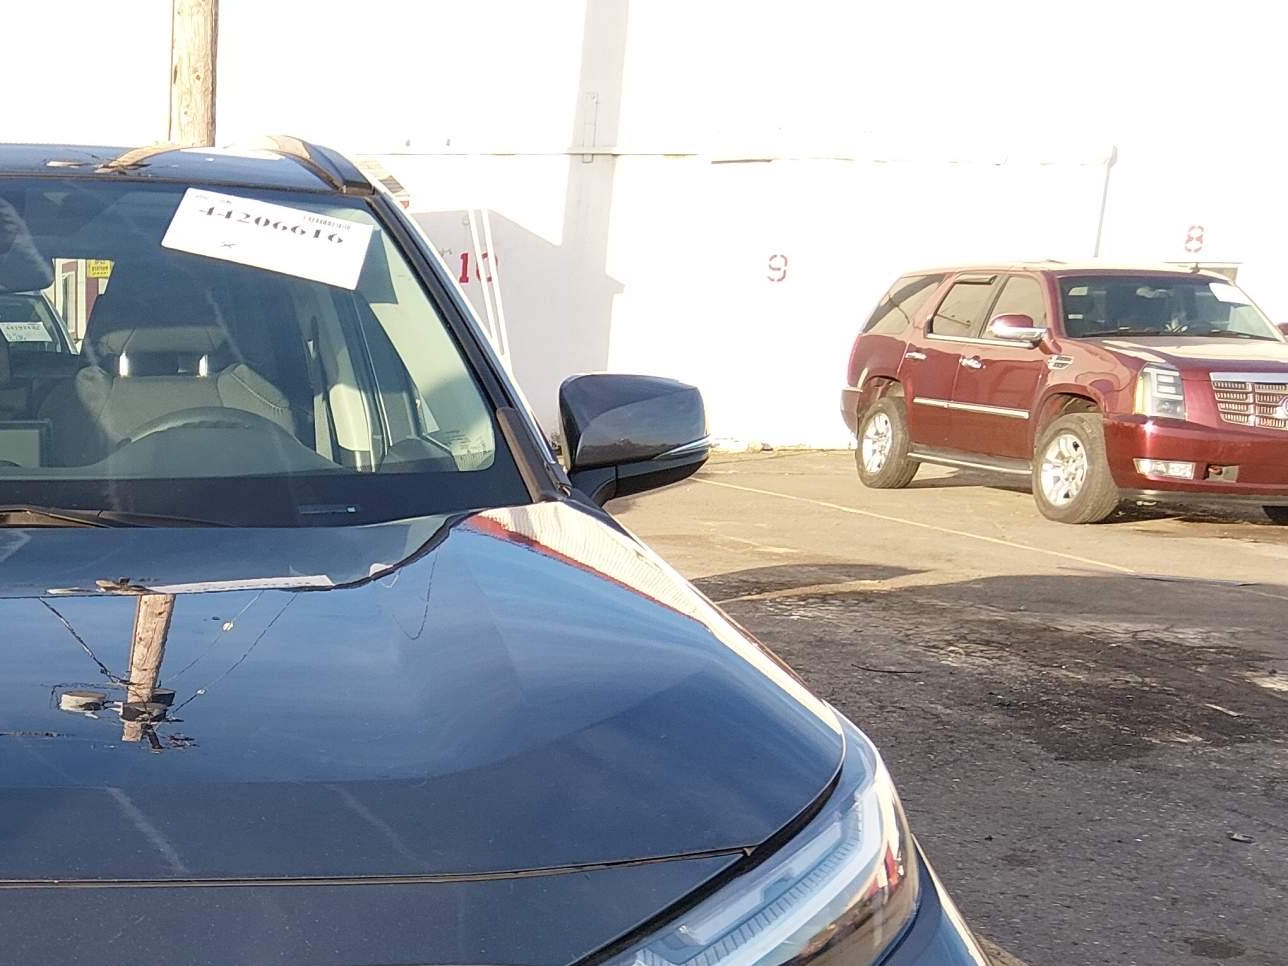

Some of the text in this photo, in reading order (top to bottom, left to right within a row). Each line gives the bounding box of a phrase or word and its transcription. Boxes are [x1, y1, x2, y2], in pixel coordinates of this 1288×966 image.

[199, 206, 344, 243] 44206616
[1184, 225, 1204, 253] 8
[767, 254, 788, 282] 9
